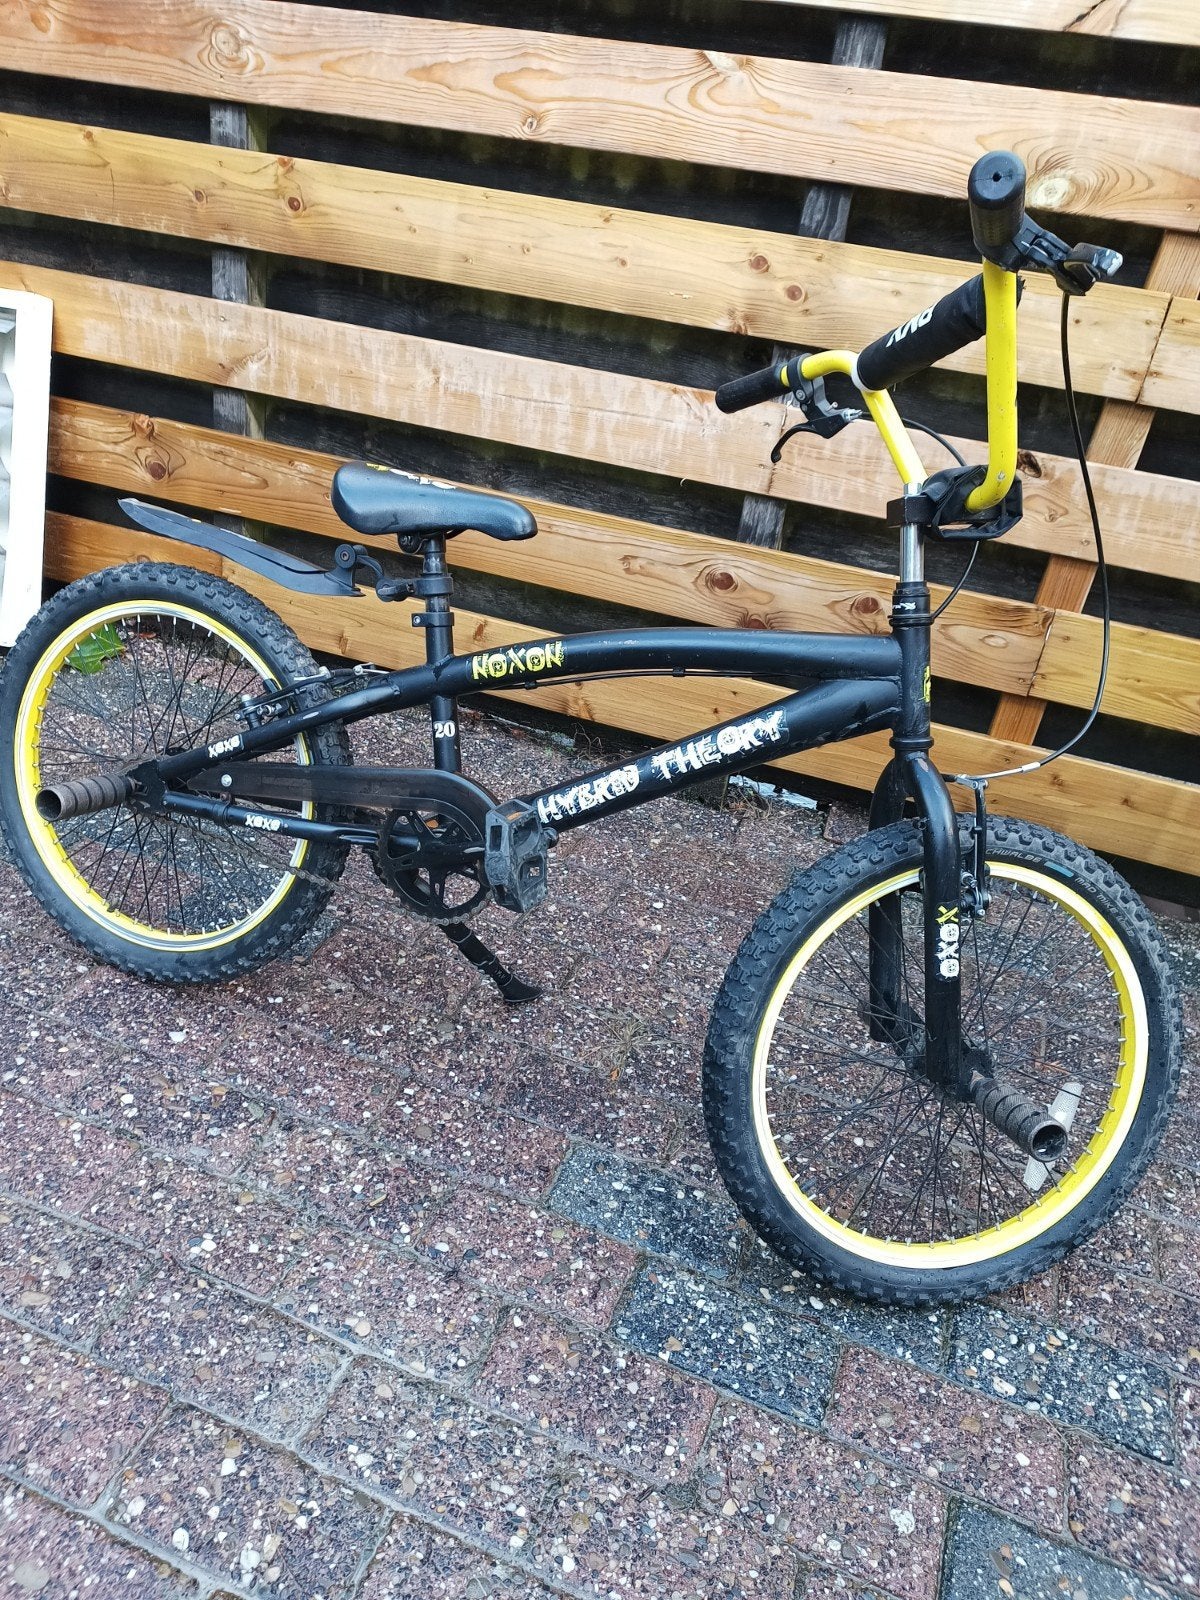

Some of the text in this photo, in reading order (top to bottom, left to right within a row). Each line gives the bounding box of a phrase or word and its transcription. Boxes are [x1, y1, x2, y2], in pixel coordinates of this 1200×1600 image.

[471, 641, 563, 679] NOXON
[434, 720, 456, 739] 20
[536, 709, 785, 824] HYBRID THEORY
[985, 848, 1119, 914] CHWALBE MAD MIKE
